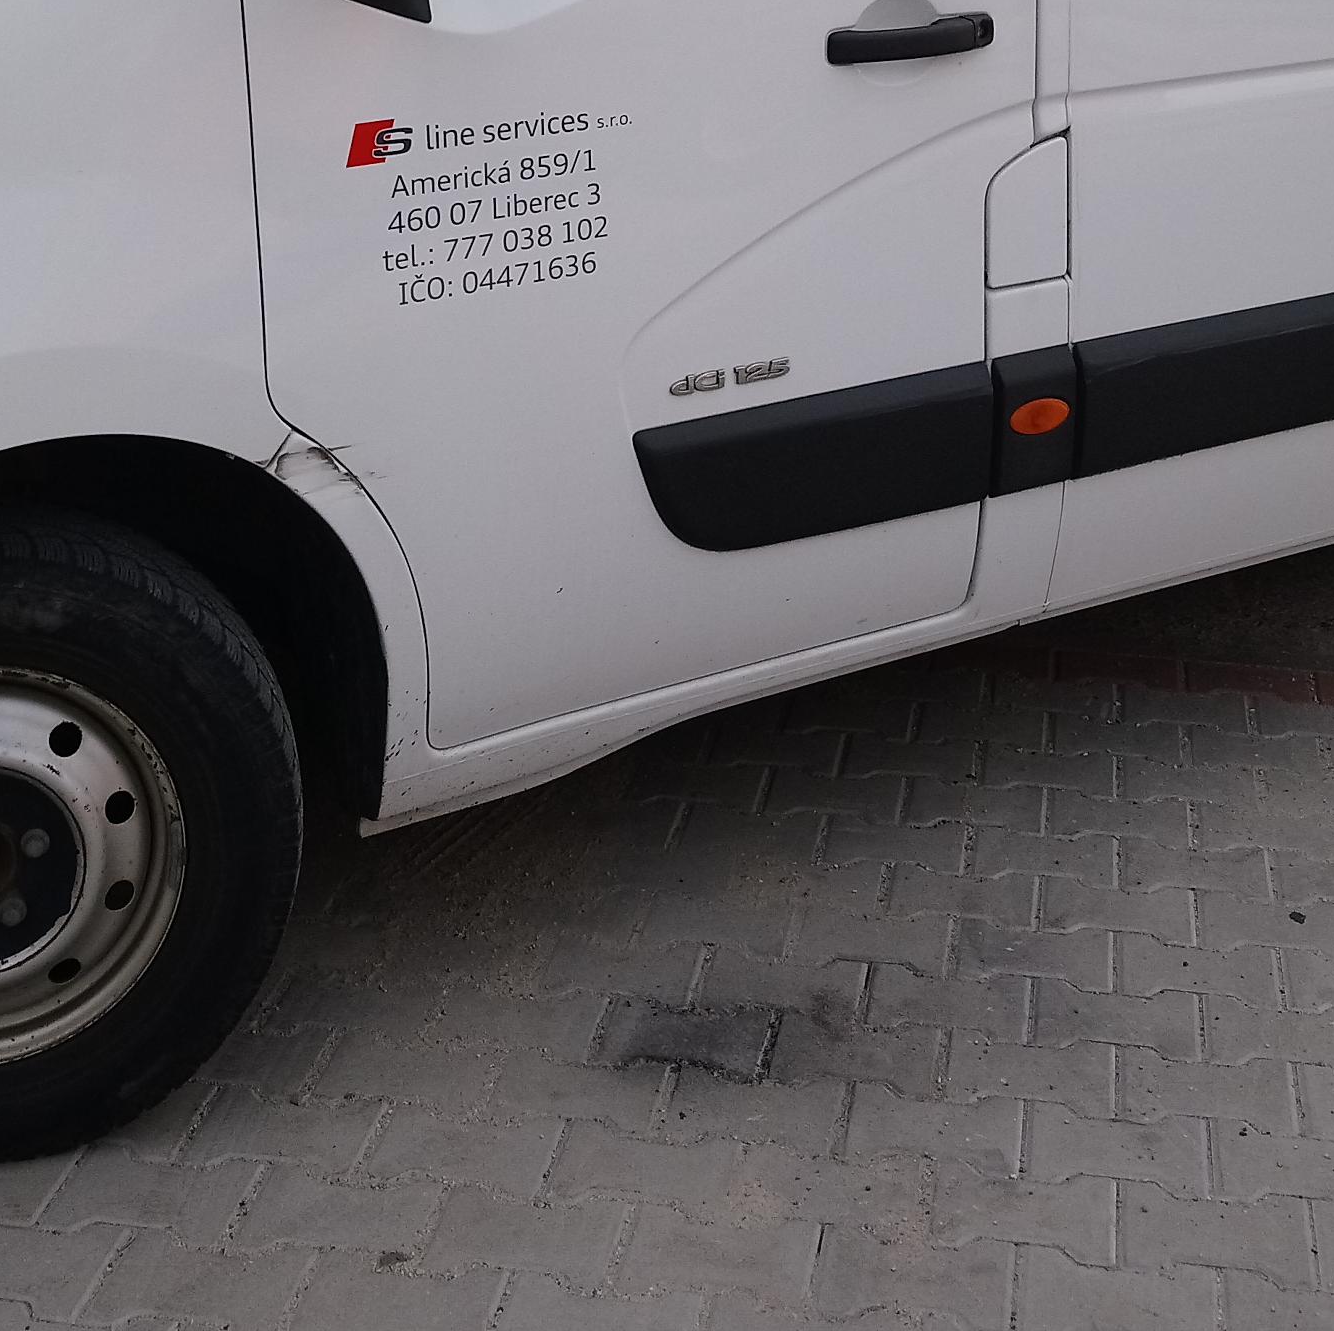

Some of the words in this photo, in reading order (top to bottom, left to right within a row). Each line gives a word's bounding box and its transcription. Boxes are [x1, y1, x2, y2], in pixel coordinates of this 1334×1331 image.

[425, 123, 475, 151] line
[482, 111, 589, 144] services
[596, 113, 633, 130] s.r.o.
[390, 160, 512, 199] Americká
[519, 149, 597, 182] 859/1
[387, 206, 442, 235] 460
[450, 200, 483, 226] 07
[492, 190, 579, 220] Liberec
[586, 183, 602, 206] 3
[382, 244, 435, 272] tel.:
[443, 232, 494, 263] 777
[503, 225, 553, 253] 038
[562, 216, 609, 244] 102
[398, 273, 454, 306] IČO:
[461, 252, 598, 295] 04471636
[669, 369, 726, 397] dCi
[733, 356, 791, 386] 125
